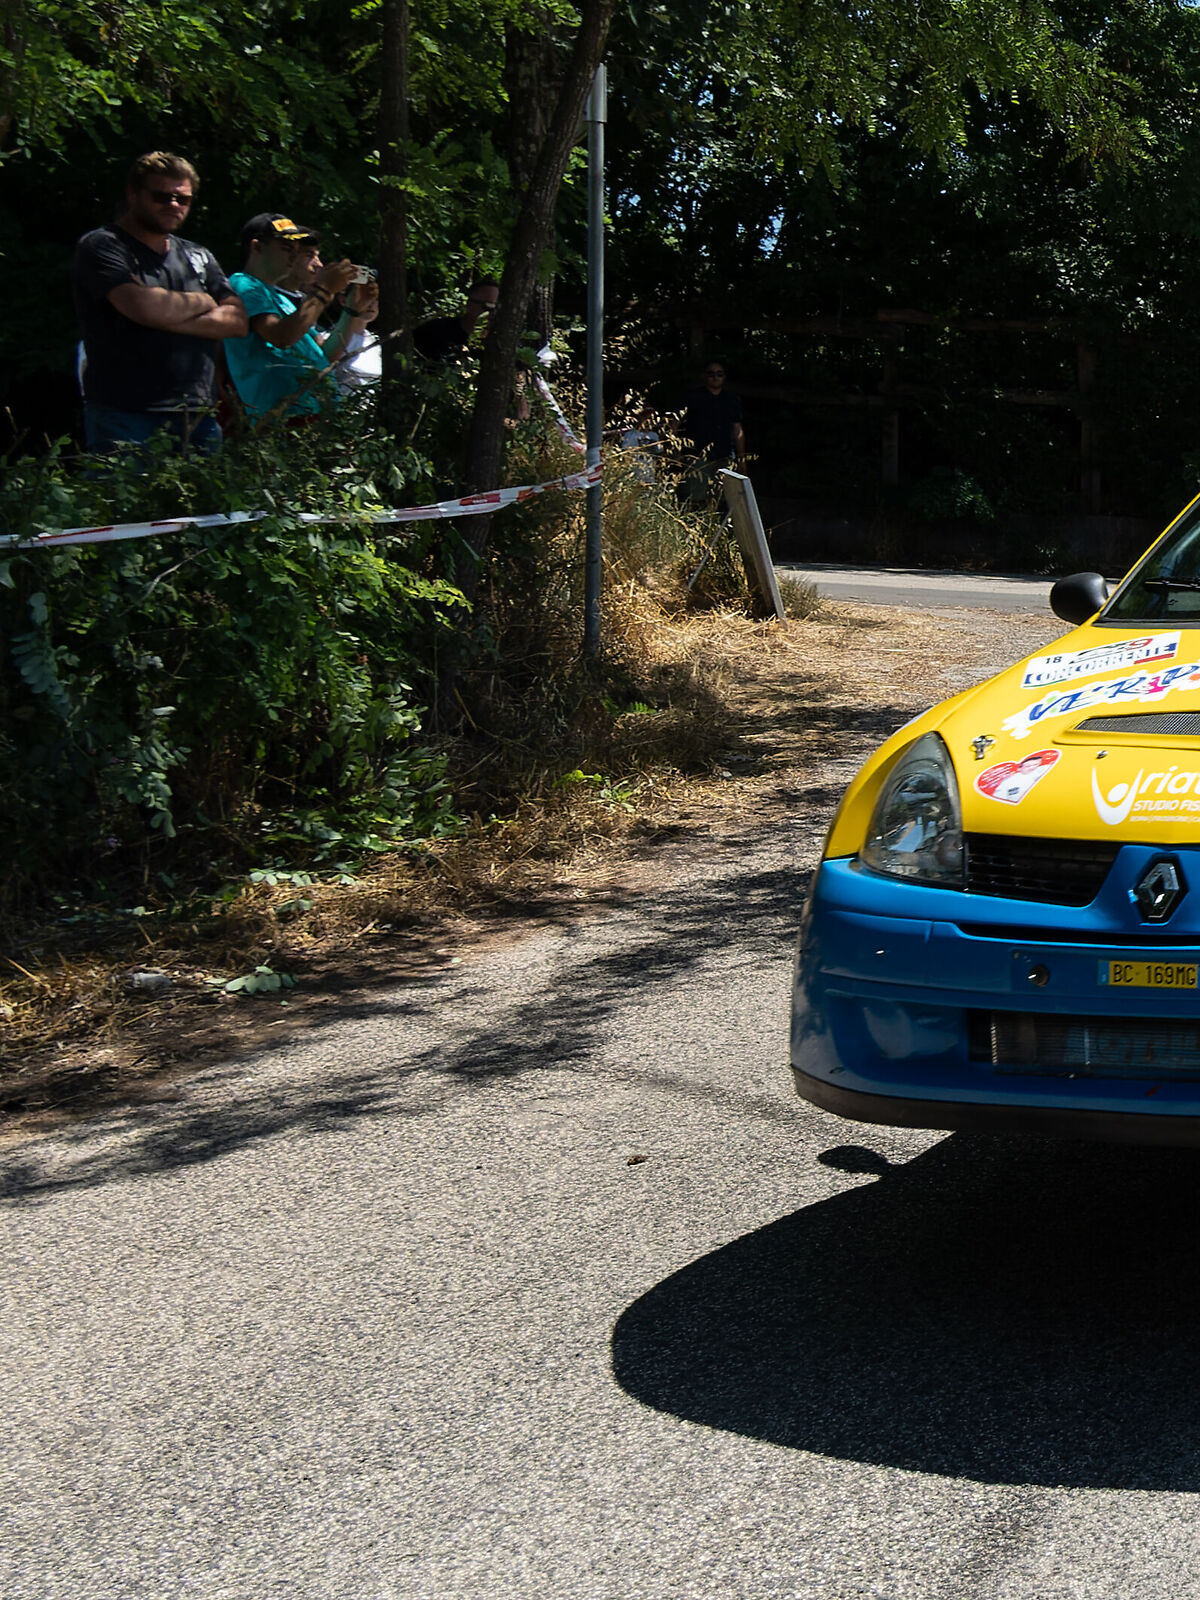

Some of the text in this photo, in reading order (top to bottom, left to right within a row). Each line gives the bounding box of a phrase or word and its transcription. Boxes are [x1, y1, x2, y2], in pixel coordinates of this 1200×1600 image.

[1045, 656, 1063, 665] 18
[1132, 800, 1179, 812] STUDIO
[1113, 964, 1196, 986] BC 169MG
